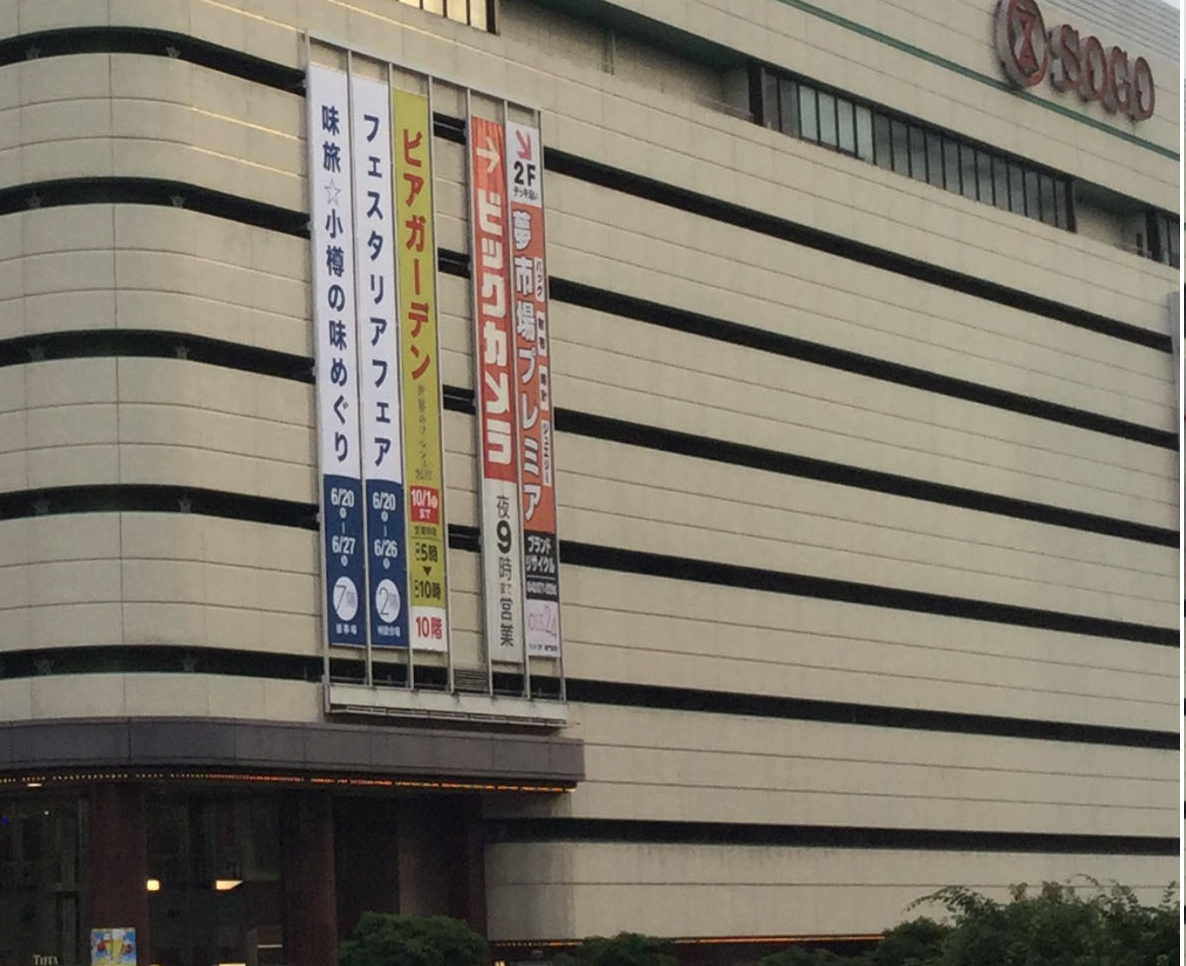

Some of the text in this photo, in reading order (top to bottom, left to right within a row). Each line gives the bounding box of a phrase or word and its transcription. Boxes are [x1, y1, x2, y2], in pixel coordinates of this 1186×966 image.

[1049, 24, 1155, 122] SOGO
[513, 161, 536, 187] 2F
[477, 189, 512, 465] ビックカメラ
[331, 488, 355, 508] 6/20
[373, 491, 396, 511] 6/20
[332, 535, 355, 555] 6/27
[374, 539, 398, 558] 6/26
